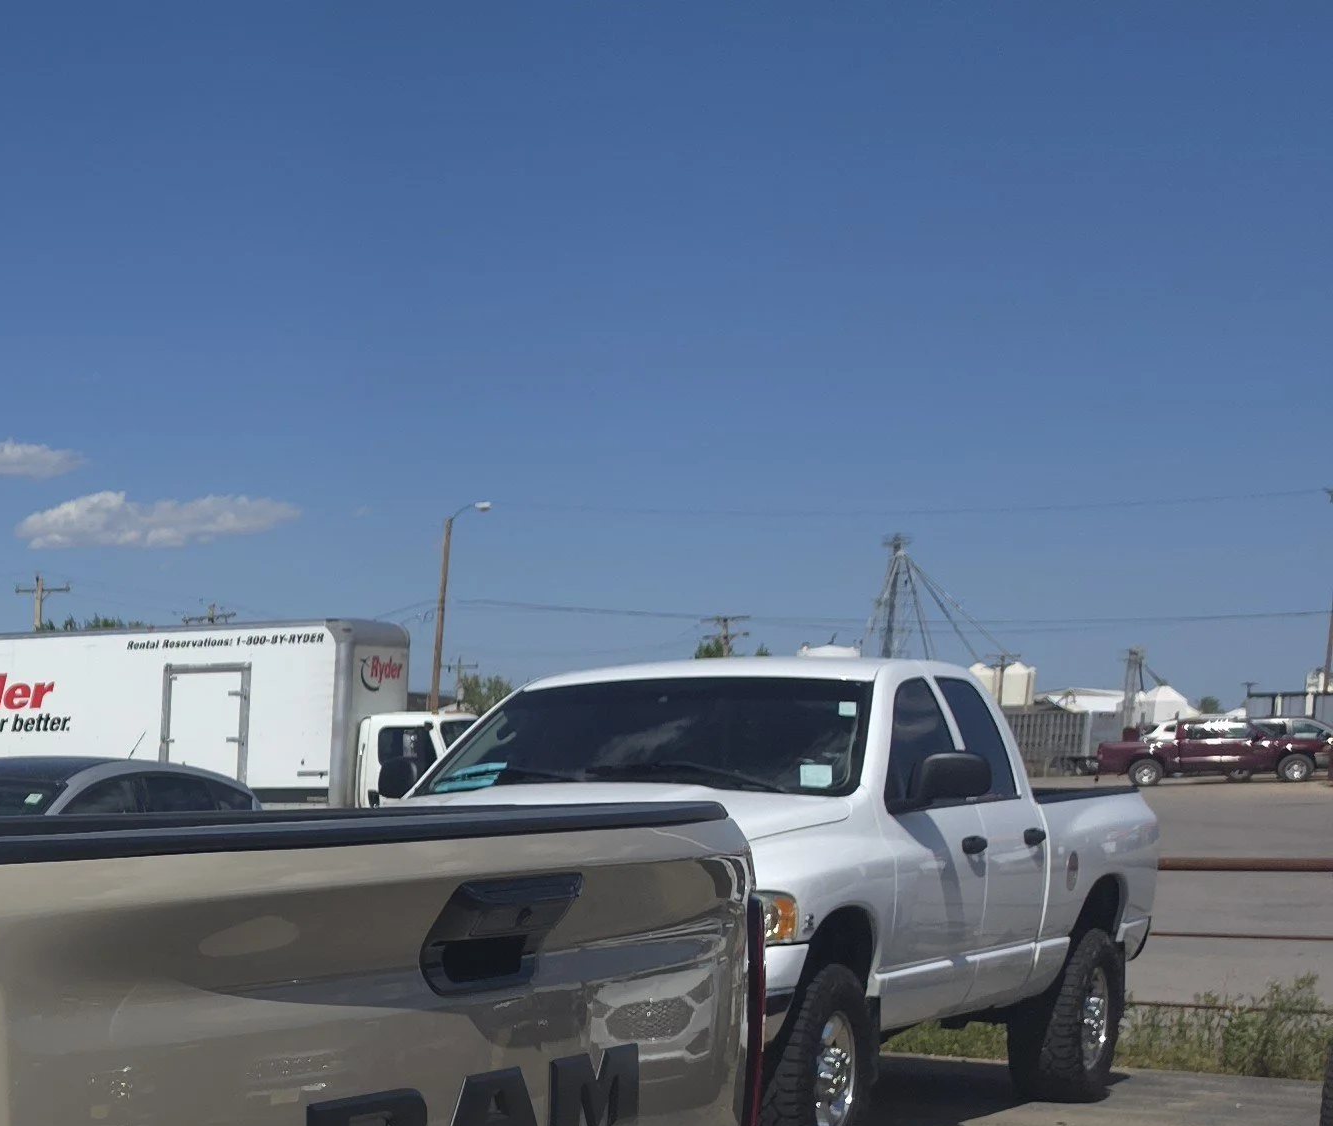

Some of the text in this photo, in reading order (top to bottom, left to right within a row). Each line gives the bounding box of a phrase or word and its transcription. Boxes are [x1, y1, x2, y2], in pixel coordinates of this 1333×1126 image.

[126, 639, 160, 651] Rental
[370, 655, 403, 685] Ryder
[11, 712, 71, 733] better.
